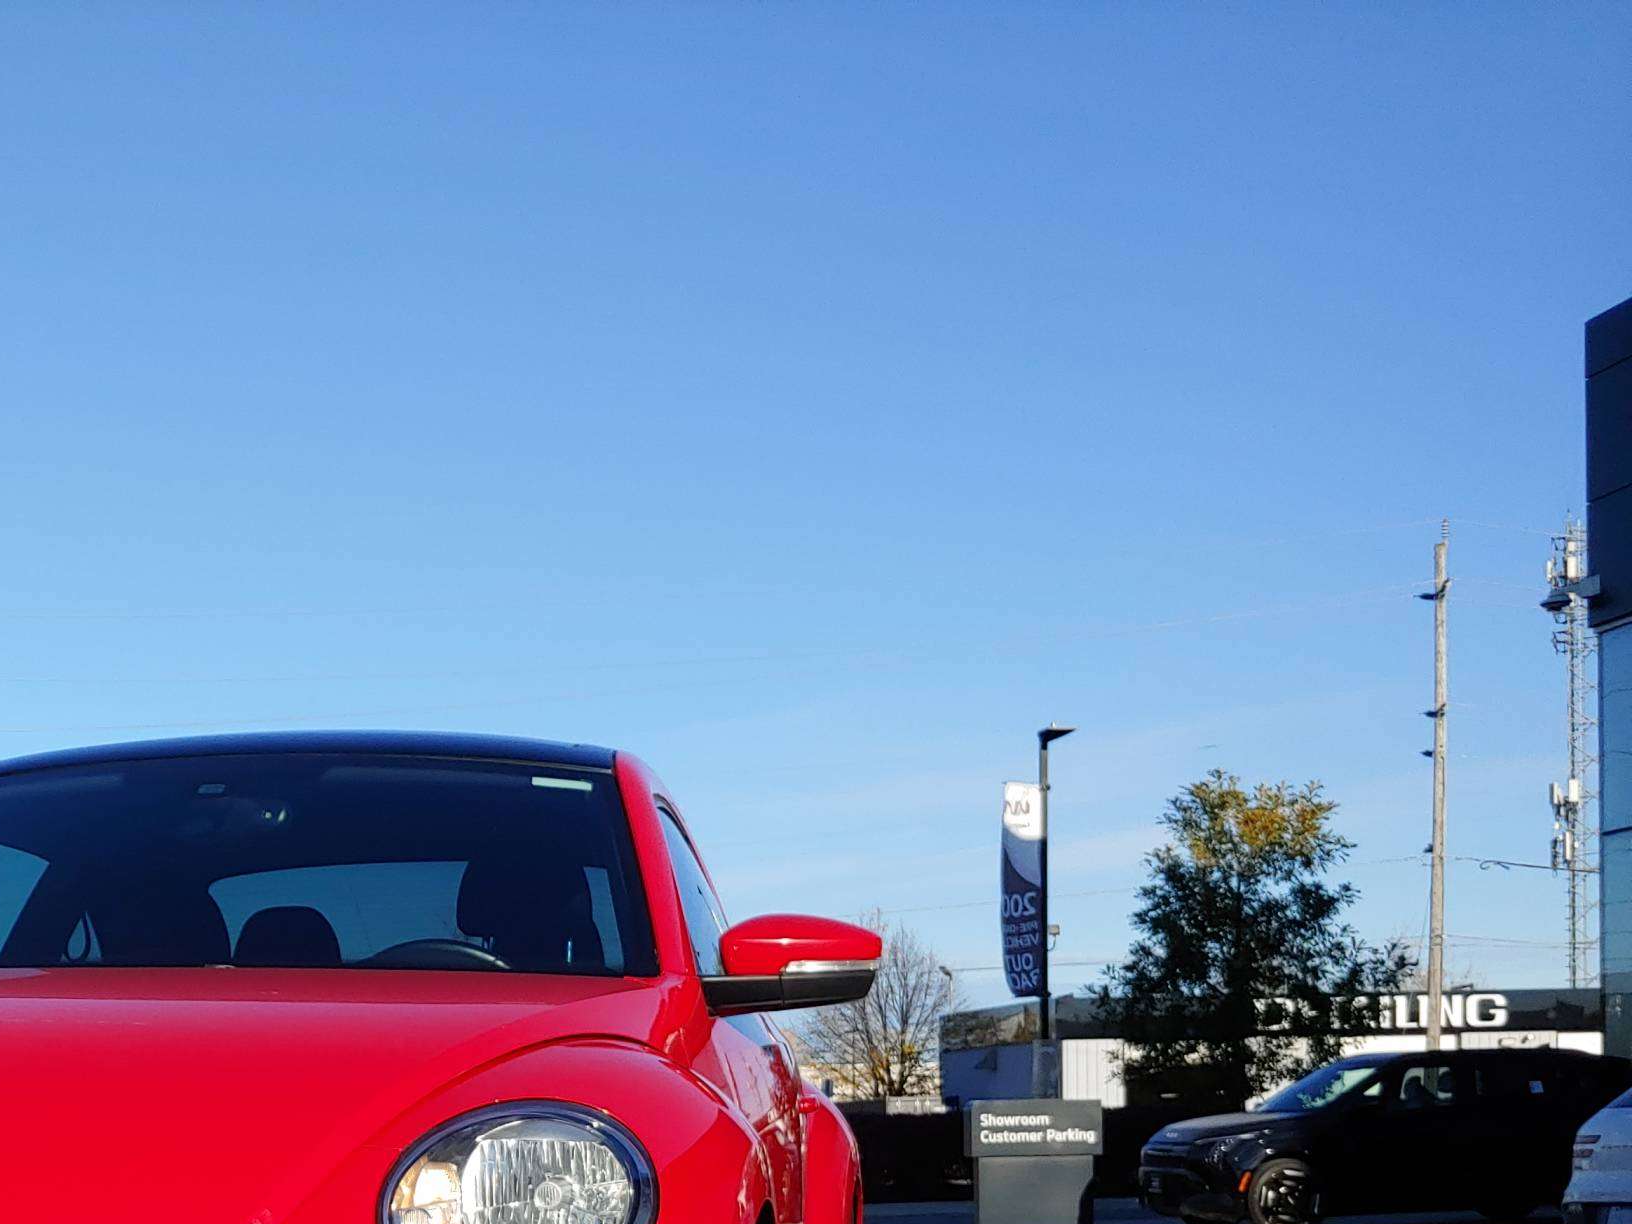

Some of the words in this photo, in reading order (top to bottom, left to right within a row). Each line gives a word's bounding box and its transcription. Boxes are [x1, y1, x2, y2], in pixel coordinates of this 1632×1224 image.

[980, 1113, 1051, 1127] Showroom
[980, 1130, 1043, 1144] Customer
[1046, 1128, 1097, 1145] Parking
